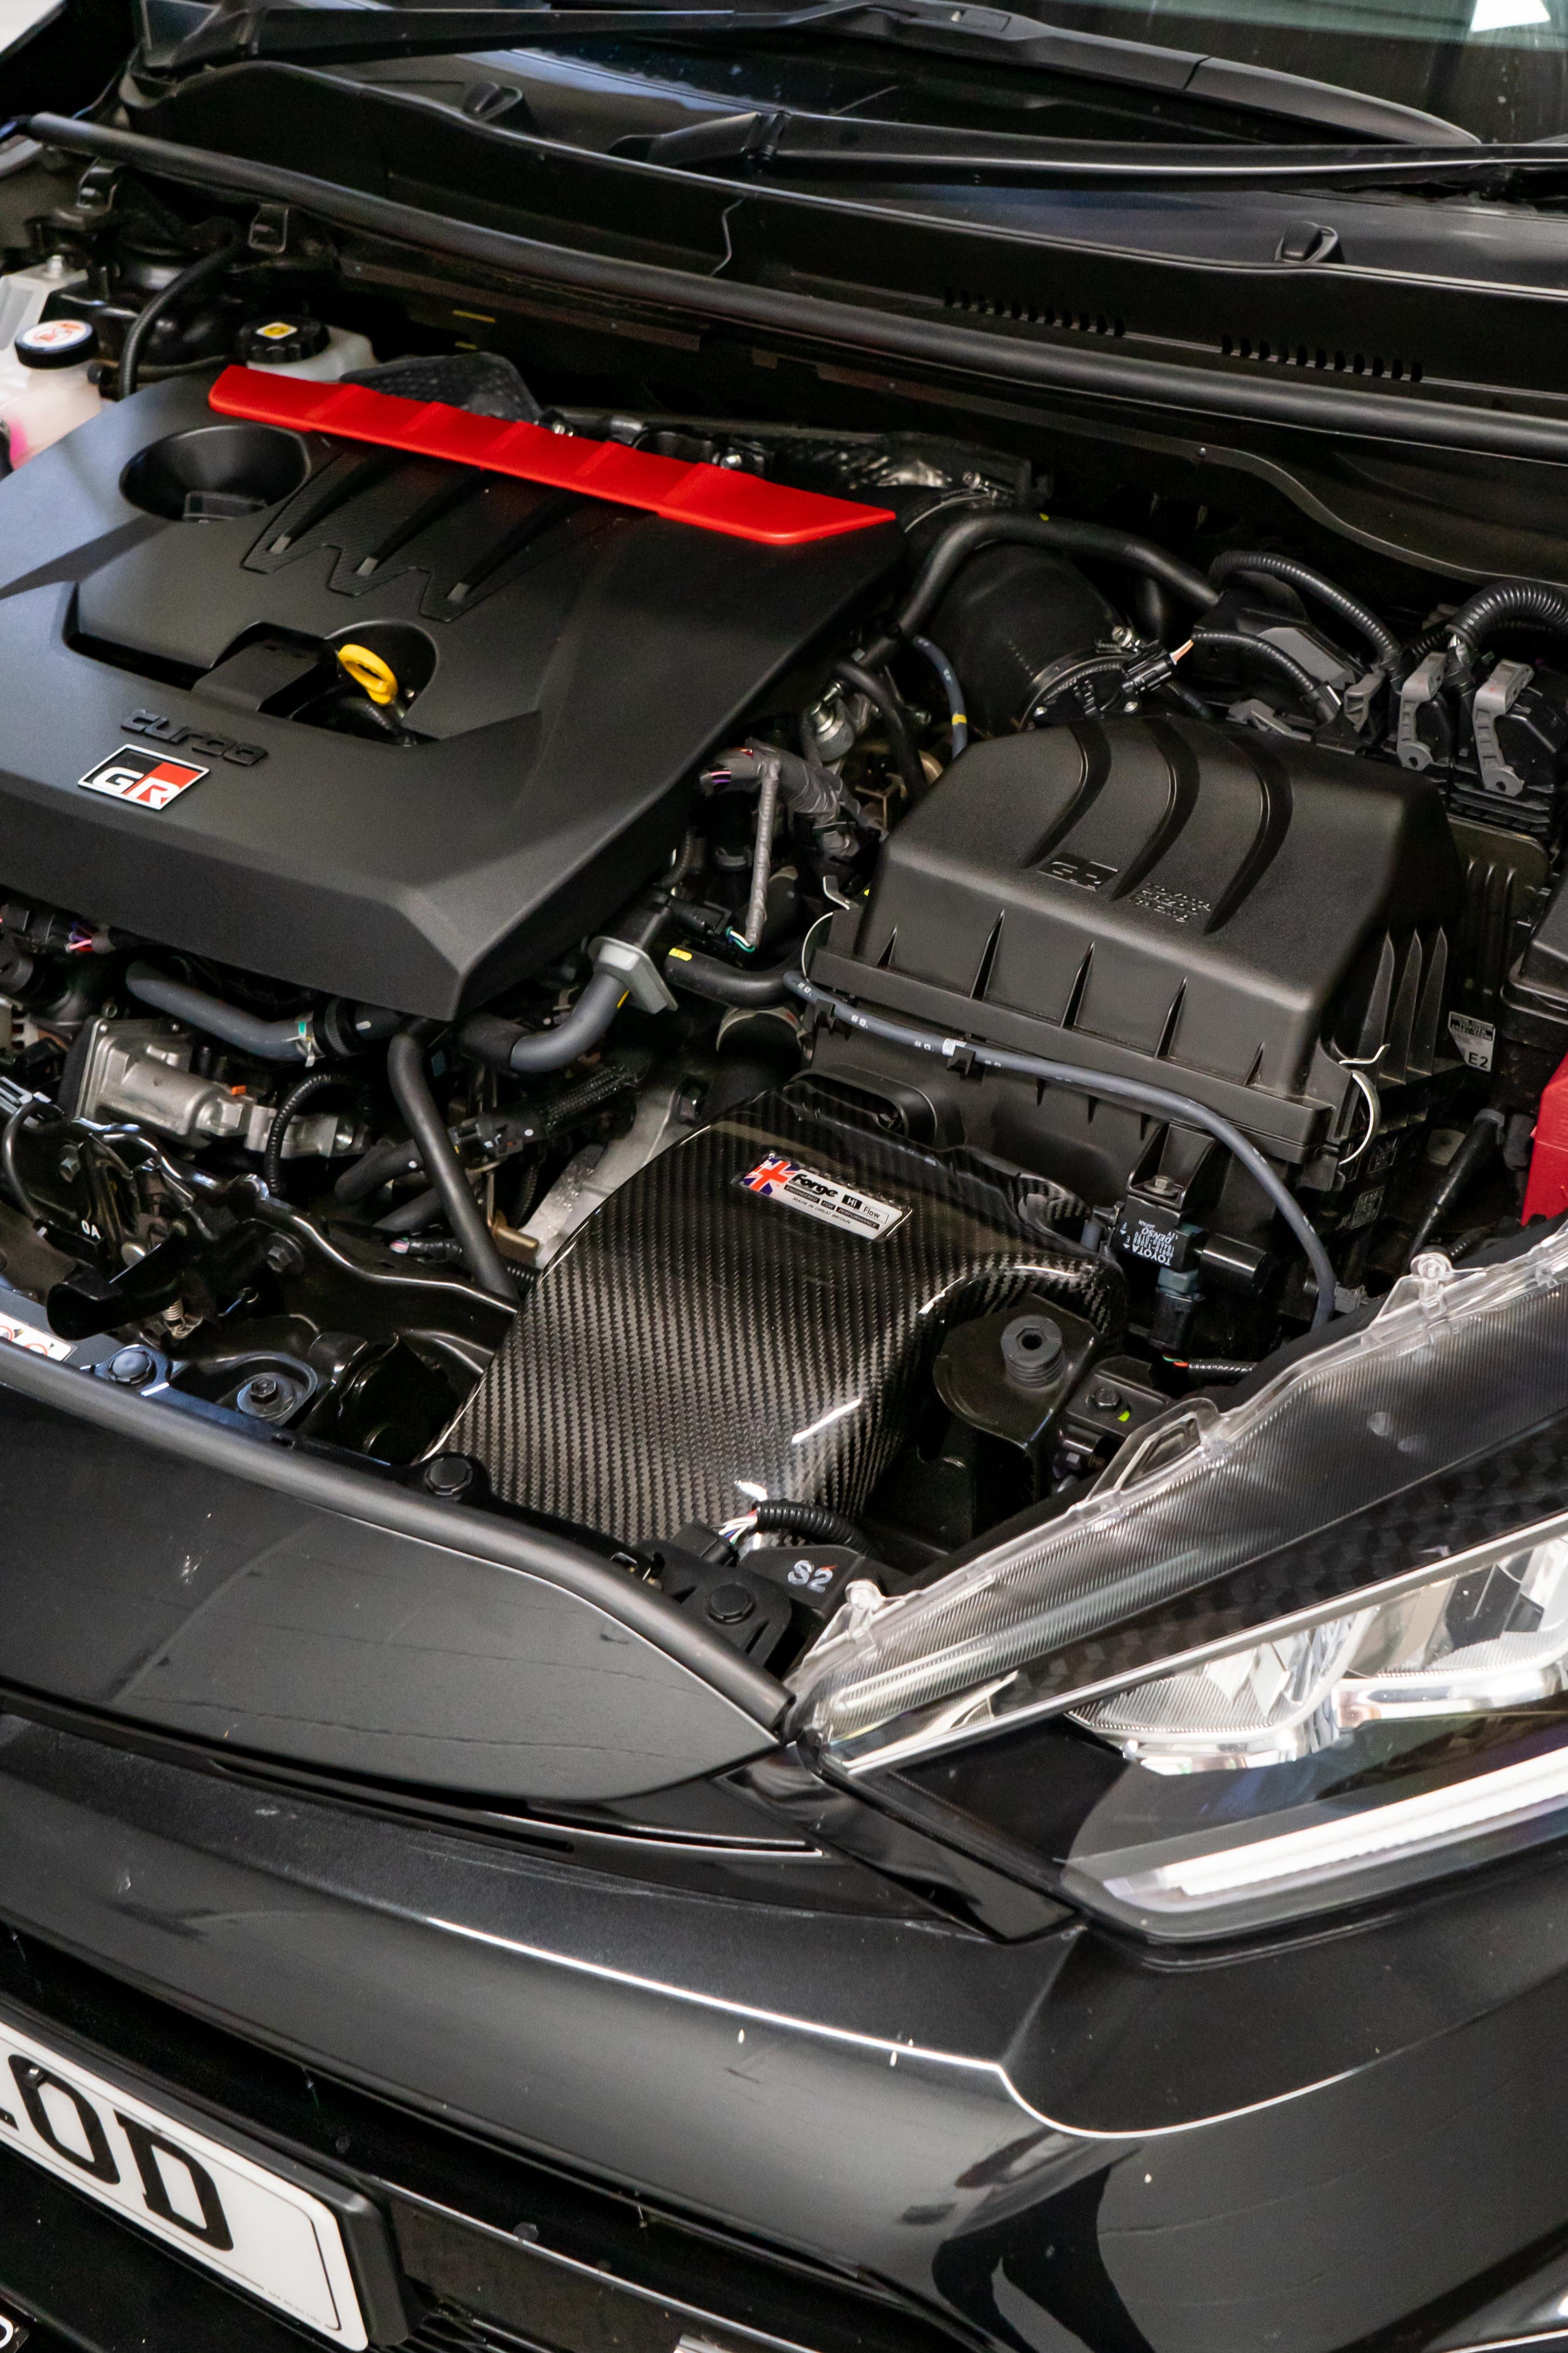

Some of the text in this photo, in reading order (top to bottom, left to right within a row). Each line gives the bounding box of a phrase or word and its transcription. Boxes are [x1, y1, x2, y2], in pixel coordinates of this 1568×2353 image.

[92, 766, 181, 807] GR
[1468, 1052, 1488, 1069] E2
[786, 1185, 879, 1228] ENGINEERED FOR PERFORMANCE
[863, 1206, 880, 1219] Flow
[1141, 1227, 1173, 1244] DENSO
[1132, 1243, 1171, 1266] TOYOTA
[788, 1559, 833, 1593] S2
